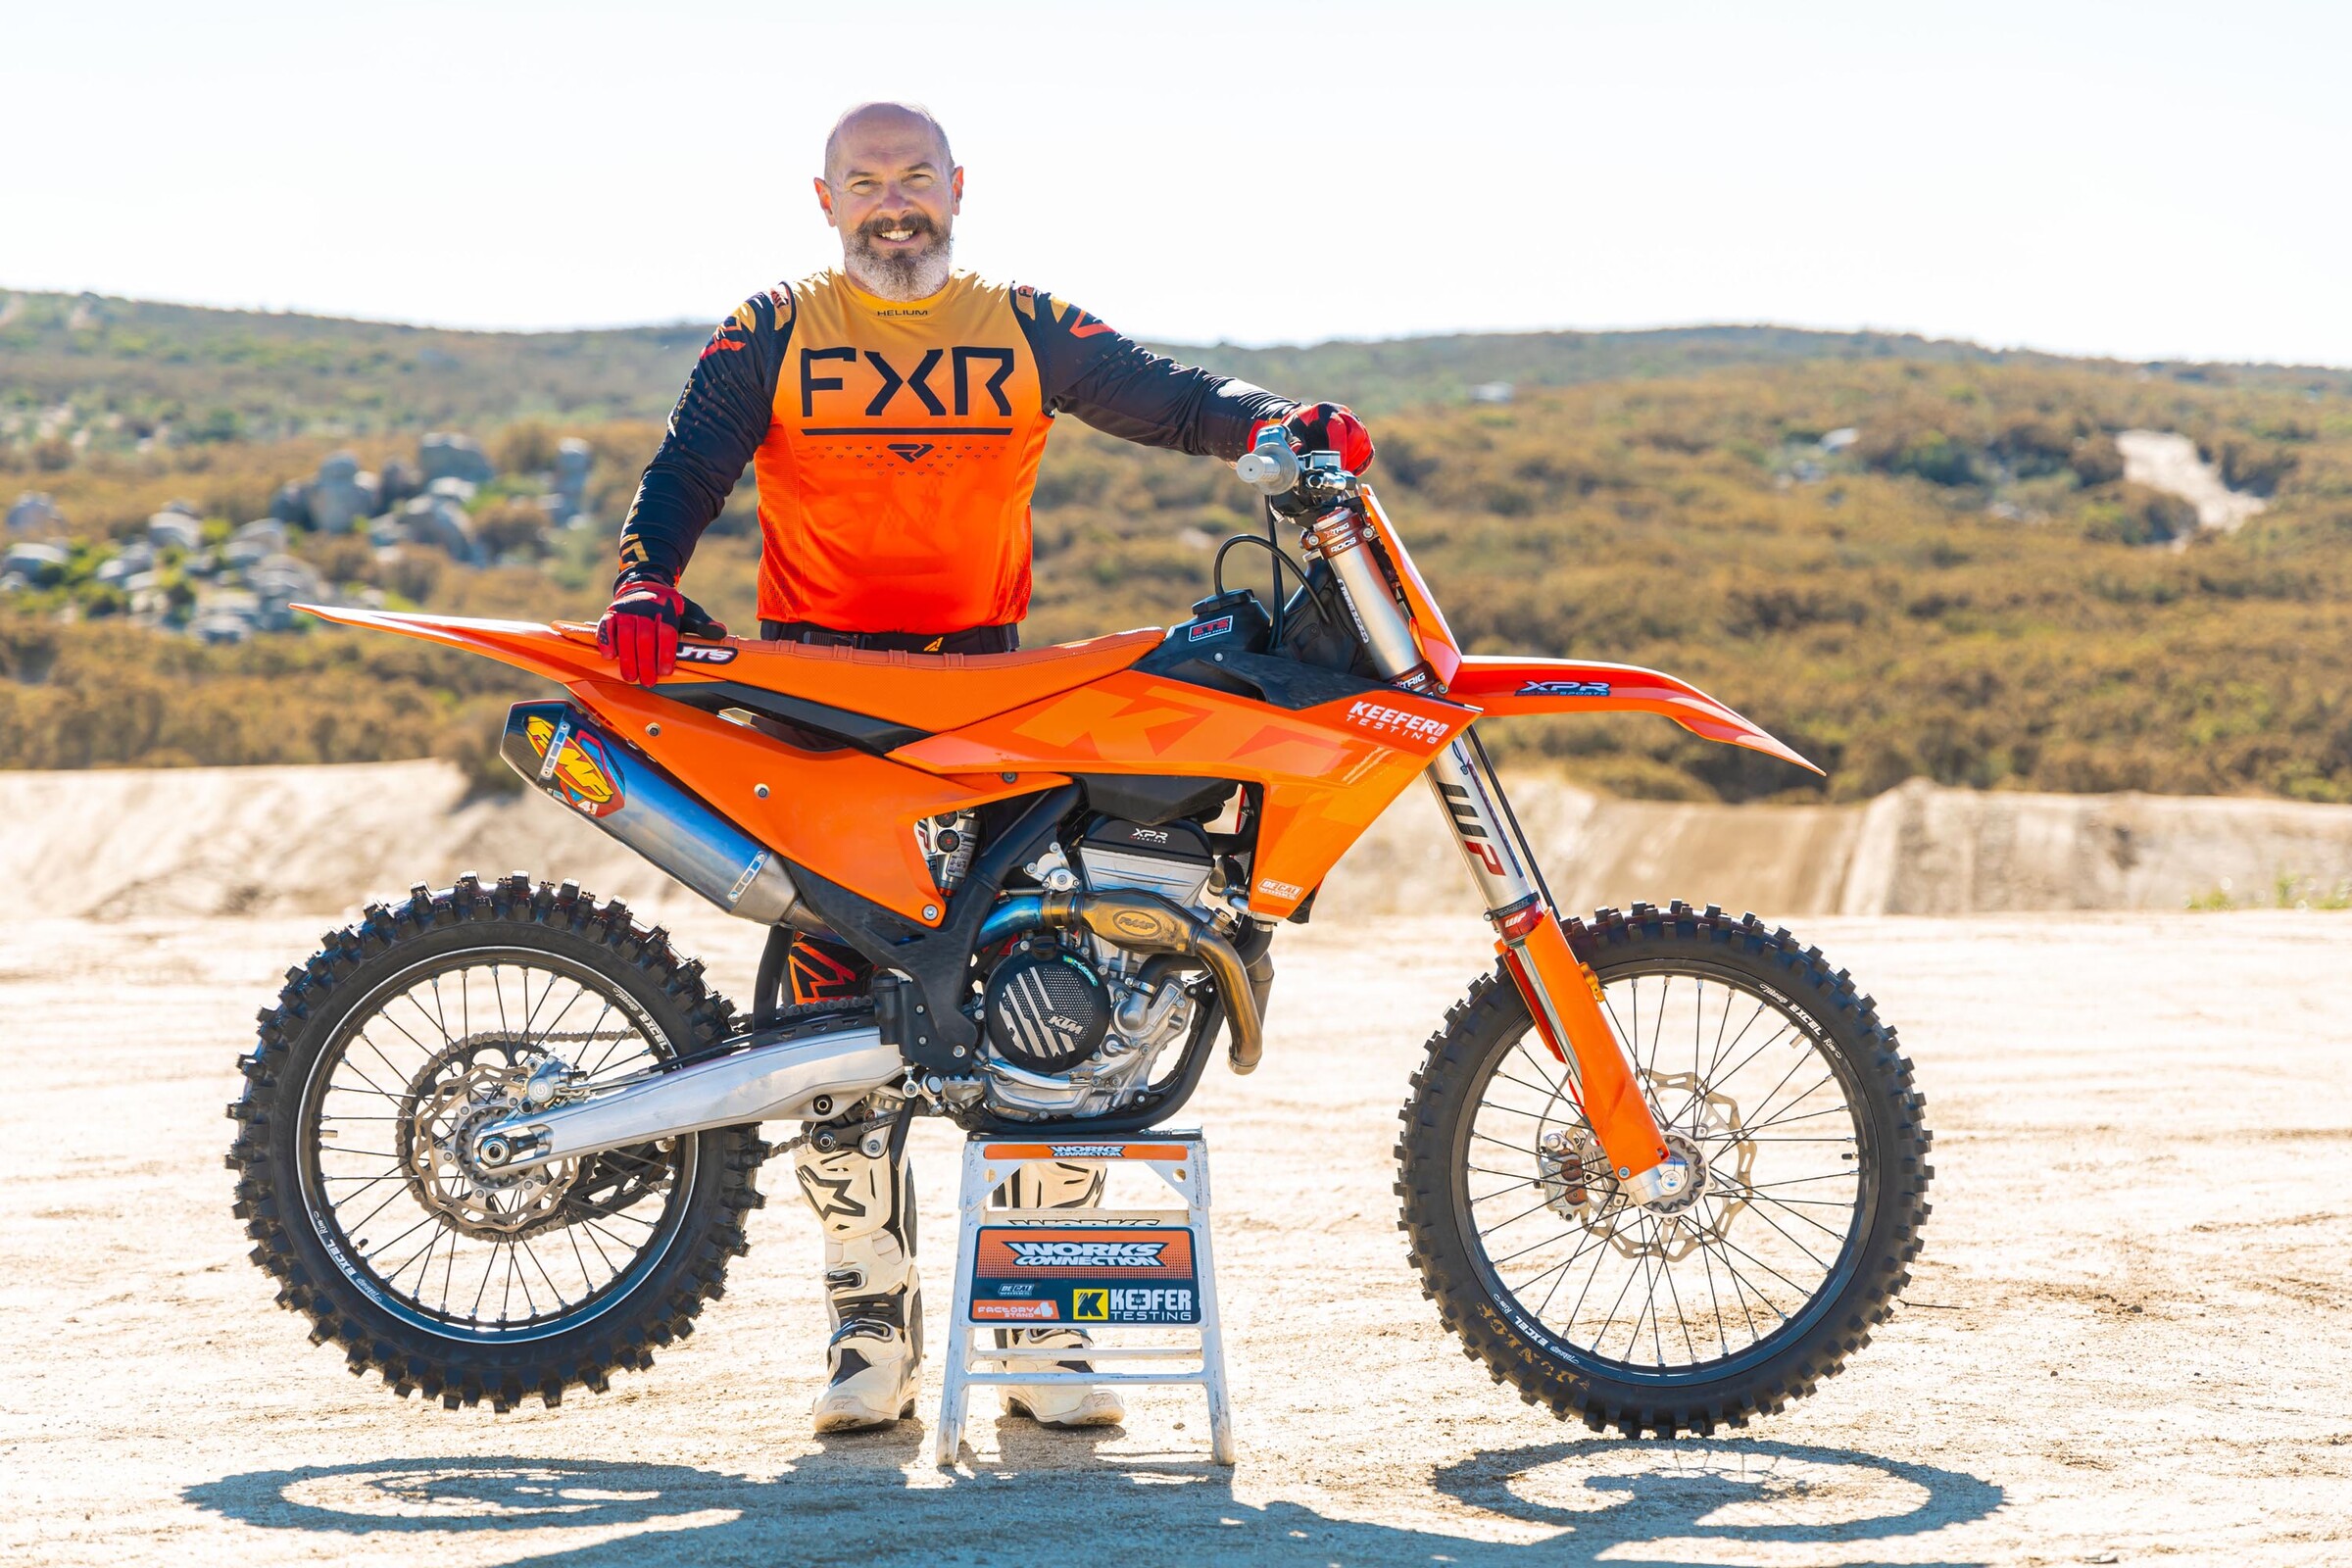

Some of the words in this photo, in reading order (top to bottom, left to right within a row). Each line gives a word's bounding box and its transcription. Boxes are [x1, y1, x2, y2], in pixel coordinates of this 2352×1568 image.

[800, 346, 1015, 417] FXR
[1330, 536, 1357, 553] ROCS
[1192, 618, 1229, 636] ETS
[1520, 680, 1610, 692] XPR
[1348, 701, 1440, 735] KEEFER
[1347, 714, 1439, 745] TESTING
[577, 800, 599, 815] 41
[1132, 827, 1168, 841] XPR
[1504, 911, 1527, 928] WP
[638, 1012, 667, 1051] EXCEL
[1049, 1014, 1084, 1035] KTM
[1788, 1003, 1822, 1036] EXCEL
[1823, 1038, 1838, 1055] Rim
[316, 1215, 329, 1235] Rim
[326, 1239, 357, 1276] EXCEL
[1007, 1242, 1164, 1256] WORKS
[1015, 1255, 1161, 1266] CONNECTION
[1497, 1298, 1512, 1314] Rim
[1110, 1311, 1192, 1321] TESTING
[1514, 1315, 1548, 1348] EXCEL
